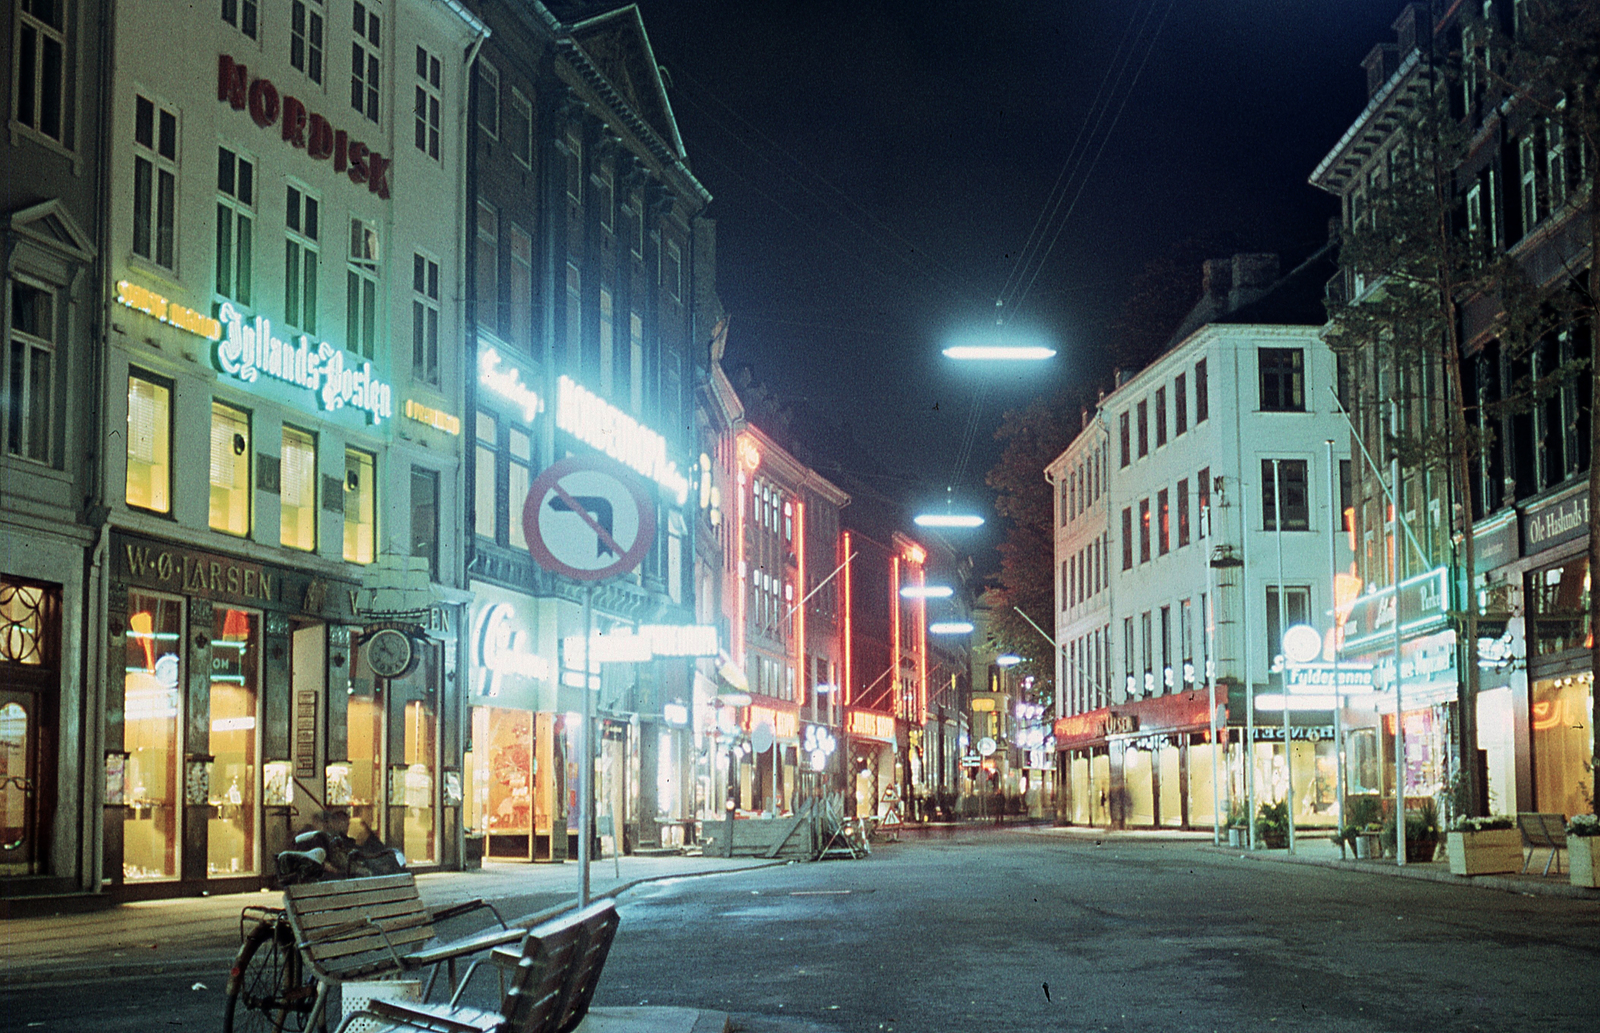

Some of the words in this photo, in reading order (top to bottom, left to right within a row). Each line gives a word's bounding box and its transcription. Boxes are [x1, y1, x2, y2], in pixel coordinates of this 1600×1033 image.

[218, 54, 392, 199] NORDISK
[1530, 516, 1545, 543] Ole
[1290, 668, 1372, 687] Fyldepenne
